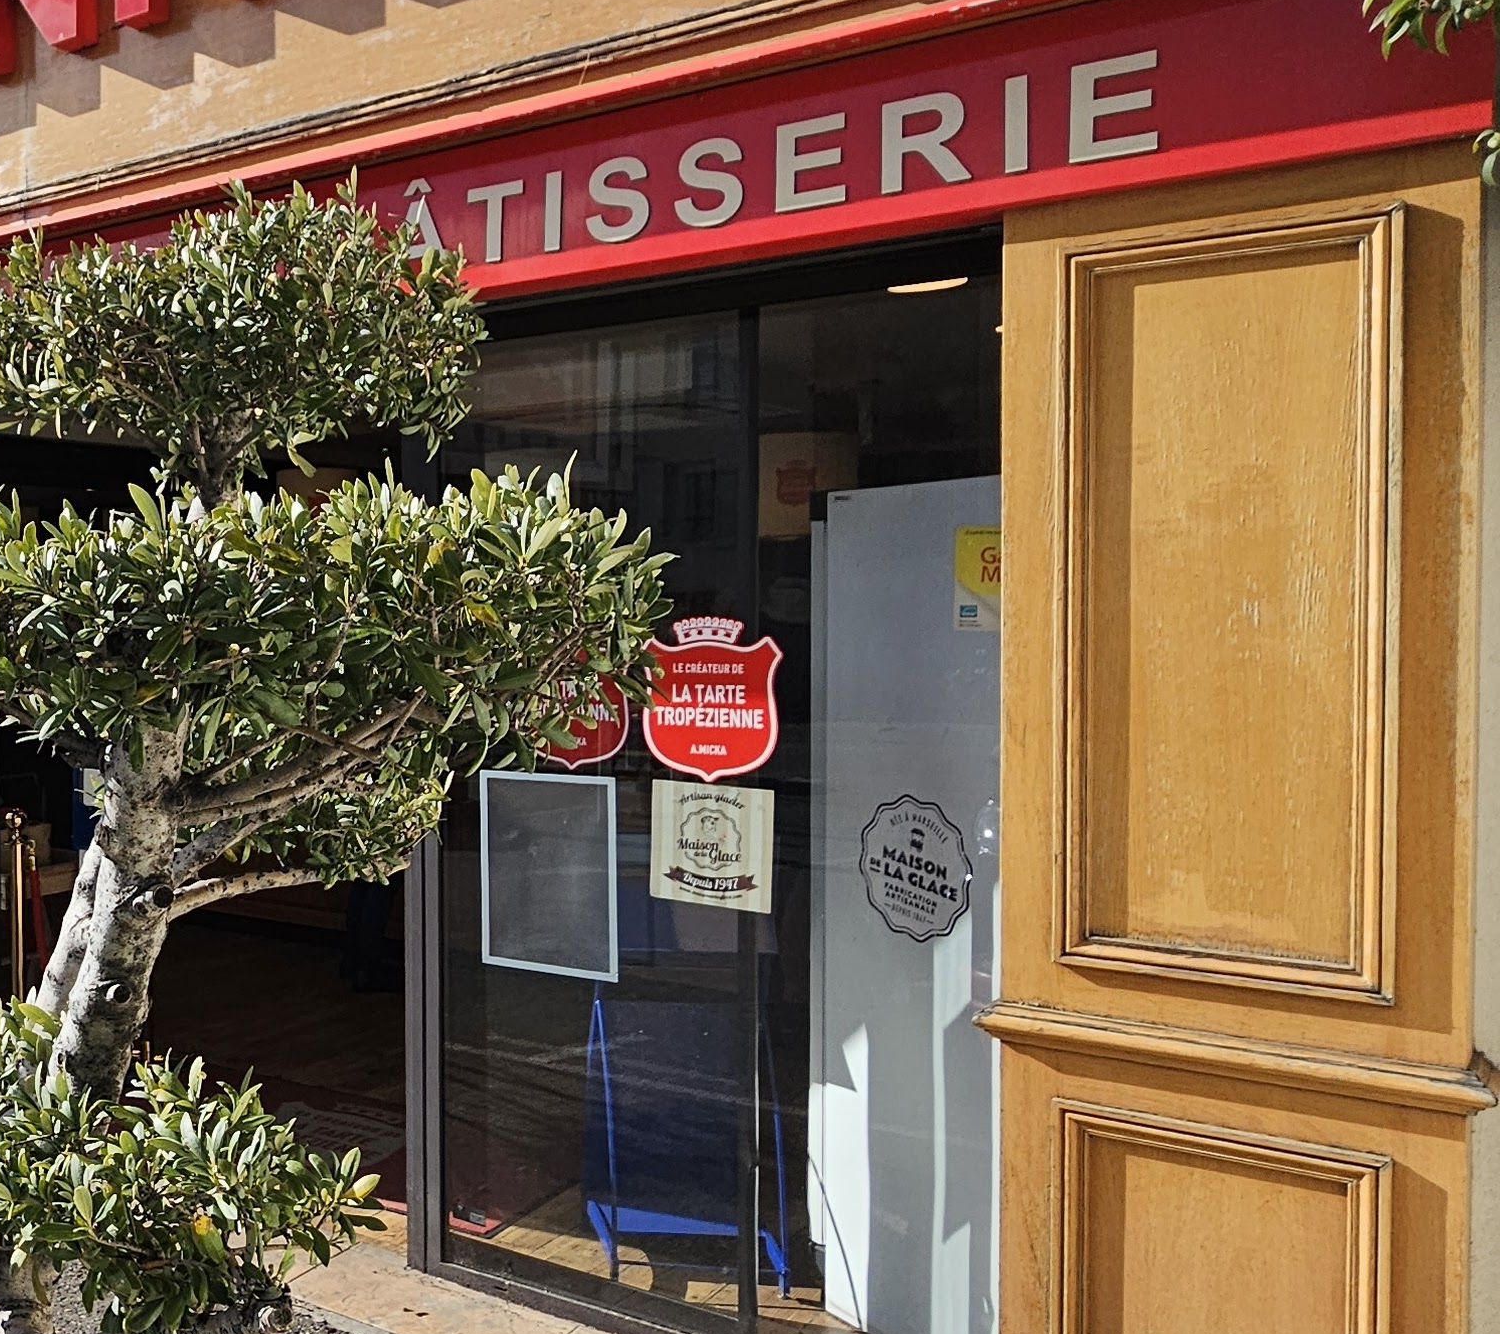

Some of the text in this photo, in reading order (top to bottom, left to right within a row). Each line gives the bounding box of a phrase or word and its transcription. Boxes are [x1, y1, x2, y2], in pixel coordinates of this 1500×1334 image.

[403, 48, 1161, 263] ÂTISSERIE
[672, 660, 745, 675] LE CRÉATEUR DE
[671, 683, 747, 705] LA TARTE
[654, 702, 764, 730] TROPÉZIENNE
[677, 837, 719, 853] Maison
[708, 849, 742, 865] Glace
[869, 856, 881, 868] DE
[882, 844, 947, 881] MAISON
[682, 871, 739, 891] Depuis 1947
[883, 861, 959, 903] LA GLACE
[884, 881, 938, 908] FABRICATION
